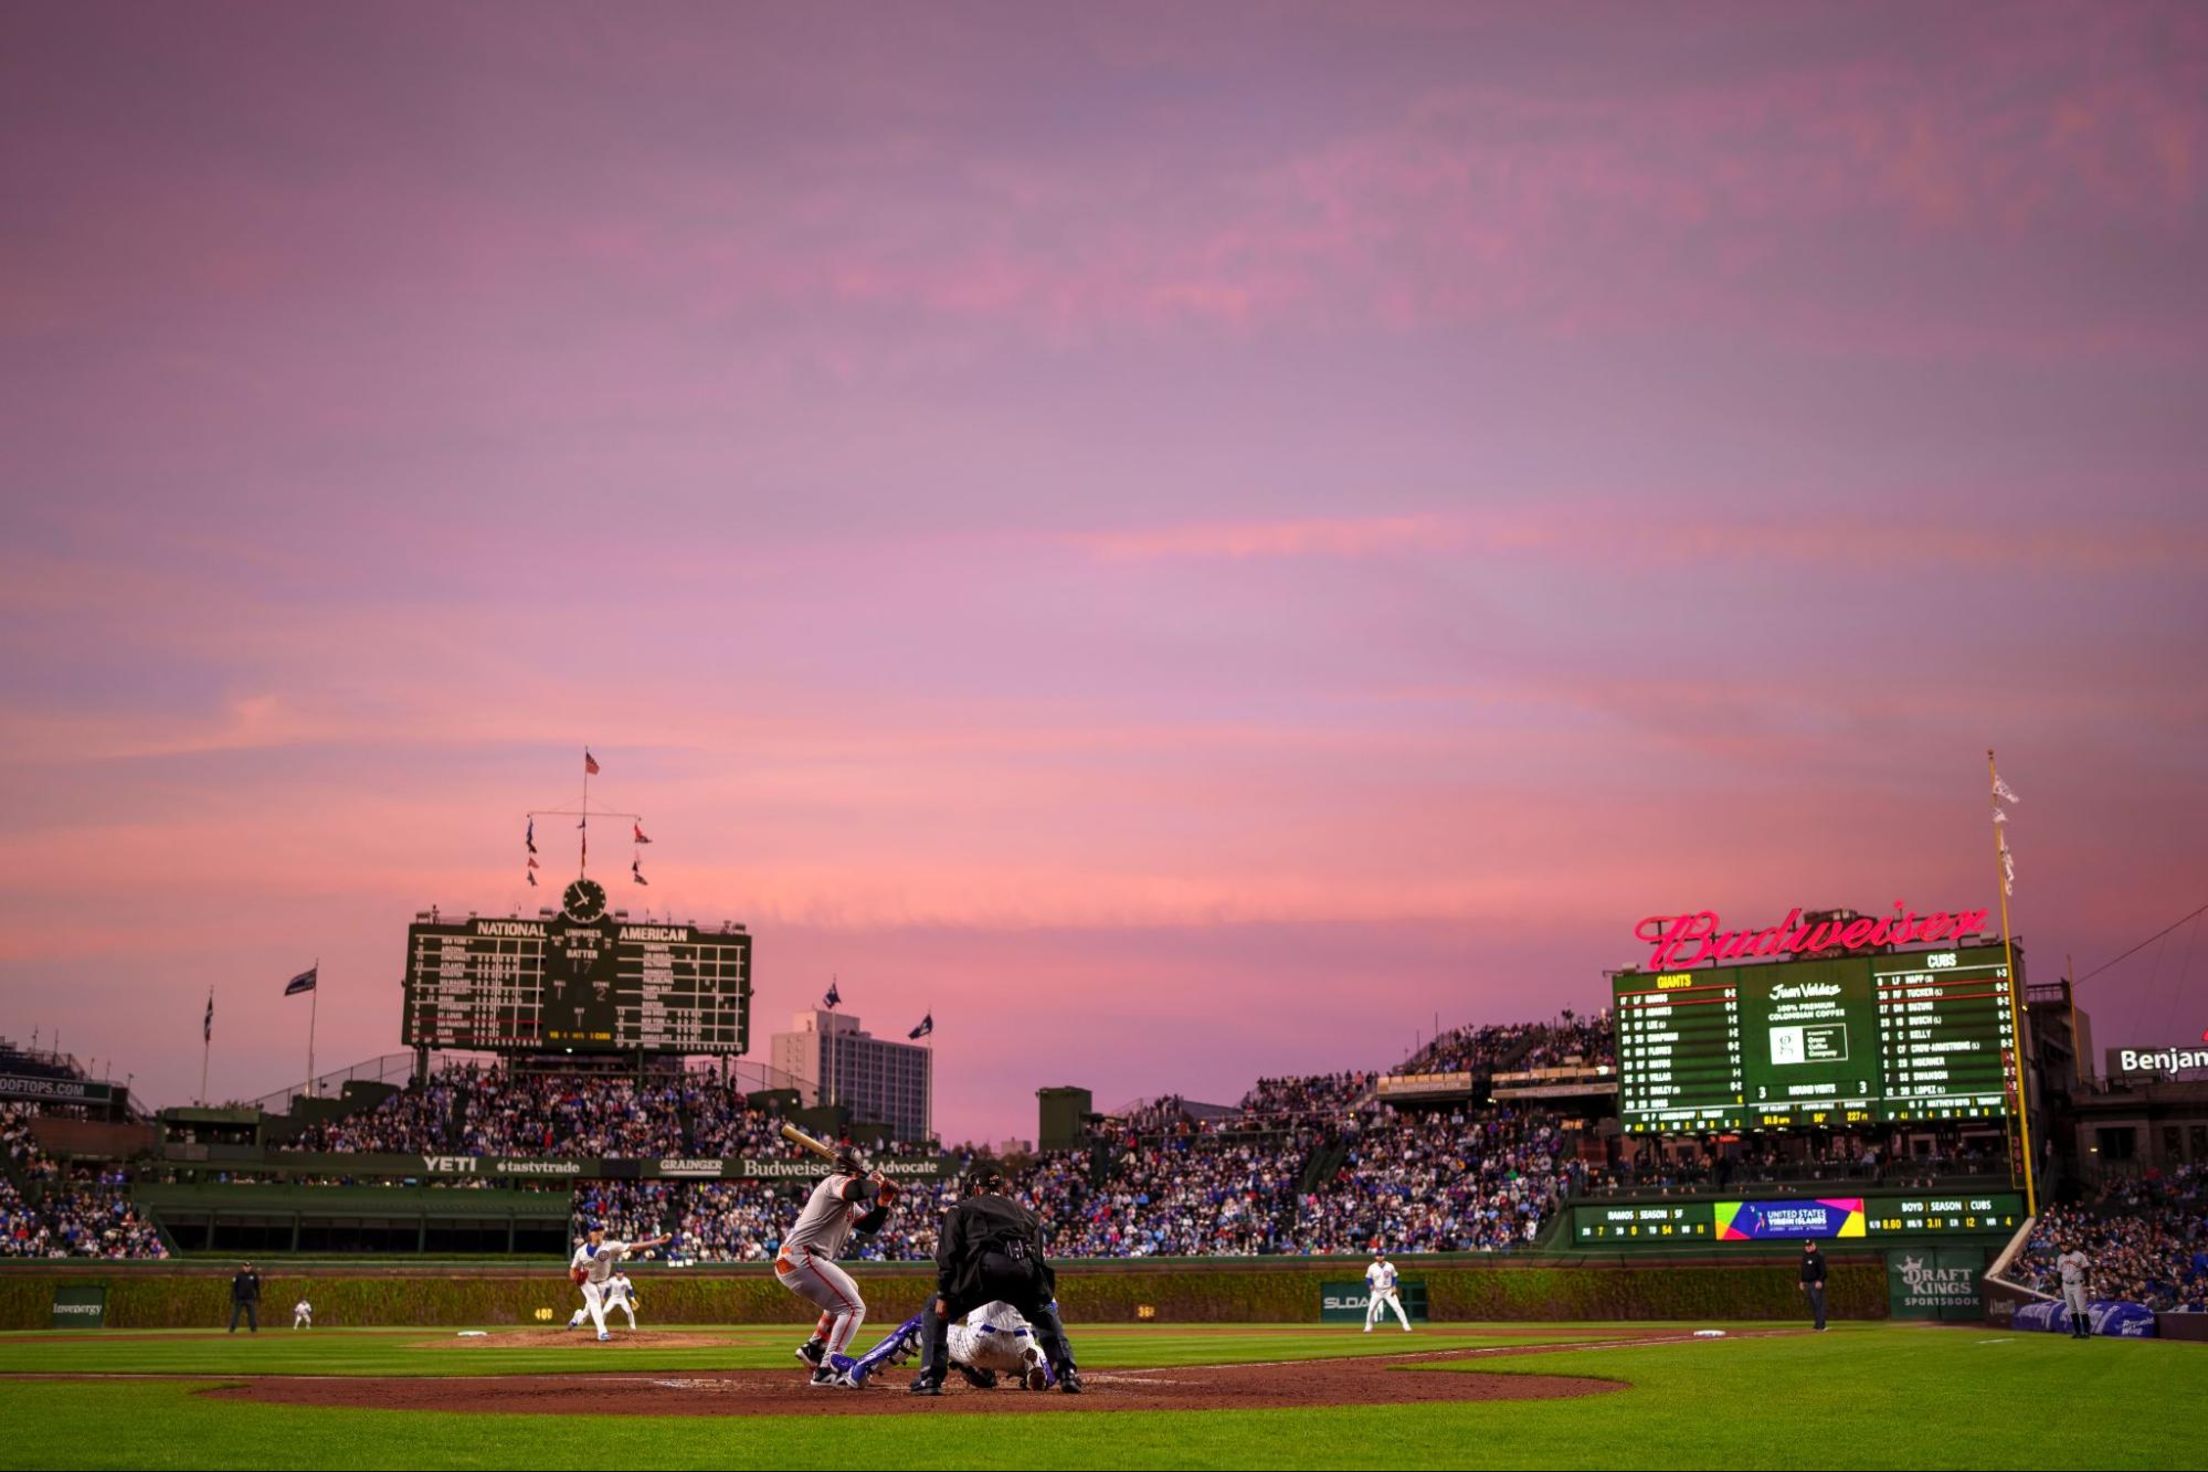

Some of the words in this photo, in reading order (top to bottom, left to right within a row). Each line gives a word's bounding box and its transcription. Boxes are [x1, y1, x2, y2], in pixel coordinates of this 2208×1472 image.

[477, 921, 547, 936] NATIONAL
[619, 927, 687, 942] AMERICAN
[1634, 900, 1989, 971] Budweiser
[566, 949, 598, 959] BATTER
[1927, 953, 1957, 968] CUBS
[1657, 974, 1692, 988] GIANTS
[1769, 983, 1801, 1000] Juan
[1759, 1086, 1766, 1099] 3
[1859, 1081, 1867, 1093] 3
[1847, 1111, 1860, 1121] 227
[423, 1156, 477, 1172] YETI
[508, 1160, 580, 1174] tastytrade
[660, 1159, 722, 1171] GRAINGER
[743, 1160, 838, 1176] Budweise
[877, 1161, 938, 1173] Advocate
[1902, 1202, 1924, 1212] BOYD
[1930, 1201, 1962, 1211] SEASON
[1970, 1200, 1992, 1211] CUBS
[1607, 1210, 1634, 1220] RAMOS
[1640, 1209, 1667, 1220] SEASON
[1767, 1210, 1797, 1219] UNITED
[1798, 1209, 1826, 1218] STATES
[1966, 1217, 1976, 1228] 12
[1902, 1269, 1973, 1284] DRAFT
[1913, 1281, 1972, 1295] KINGS
[1324, 1297, 1372, 1309] SLOA
[1904, 1297, 1980, 1306] SPORTSBOOK
[53, 1303, 102, 1316] Invenergy
[535, 1308, 553, 1320] 400
